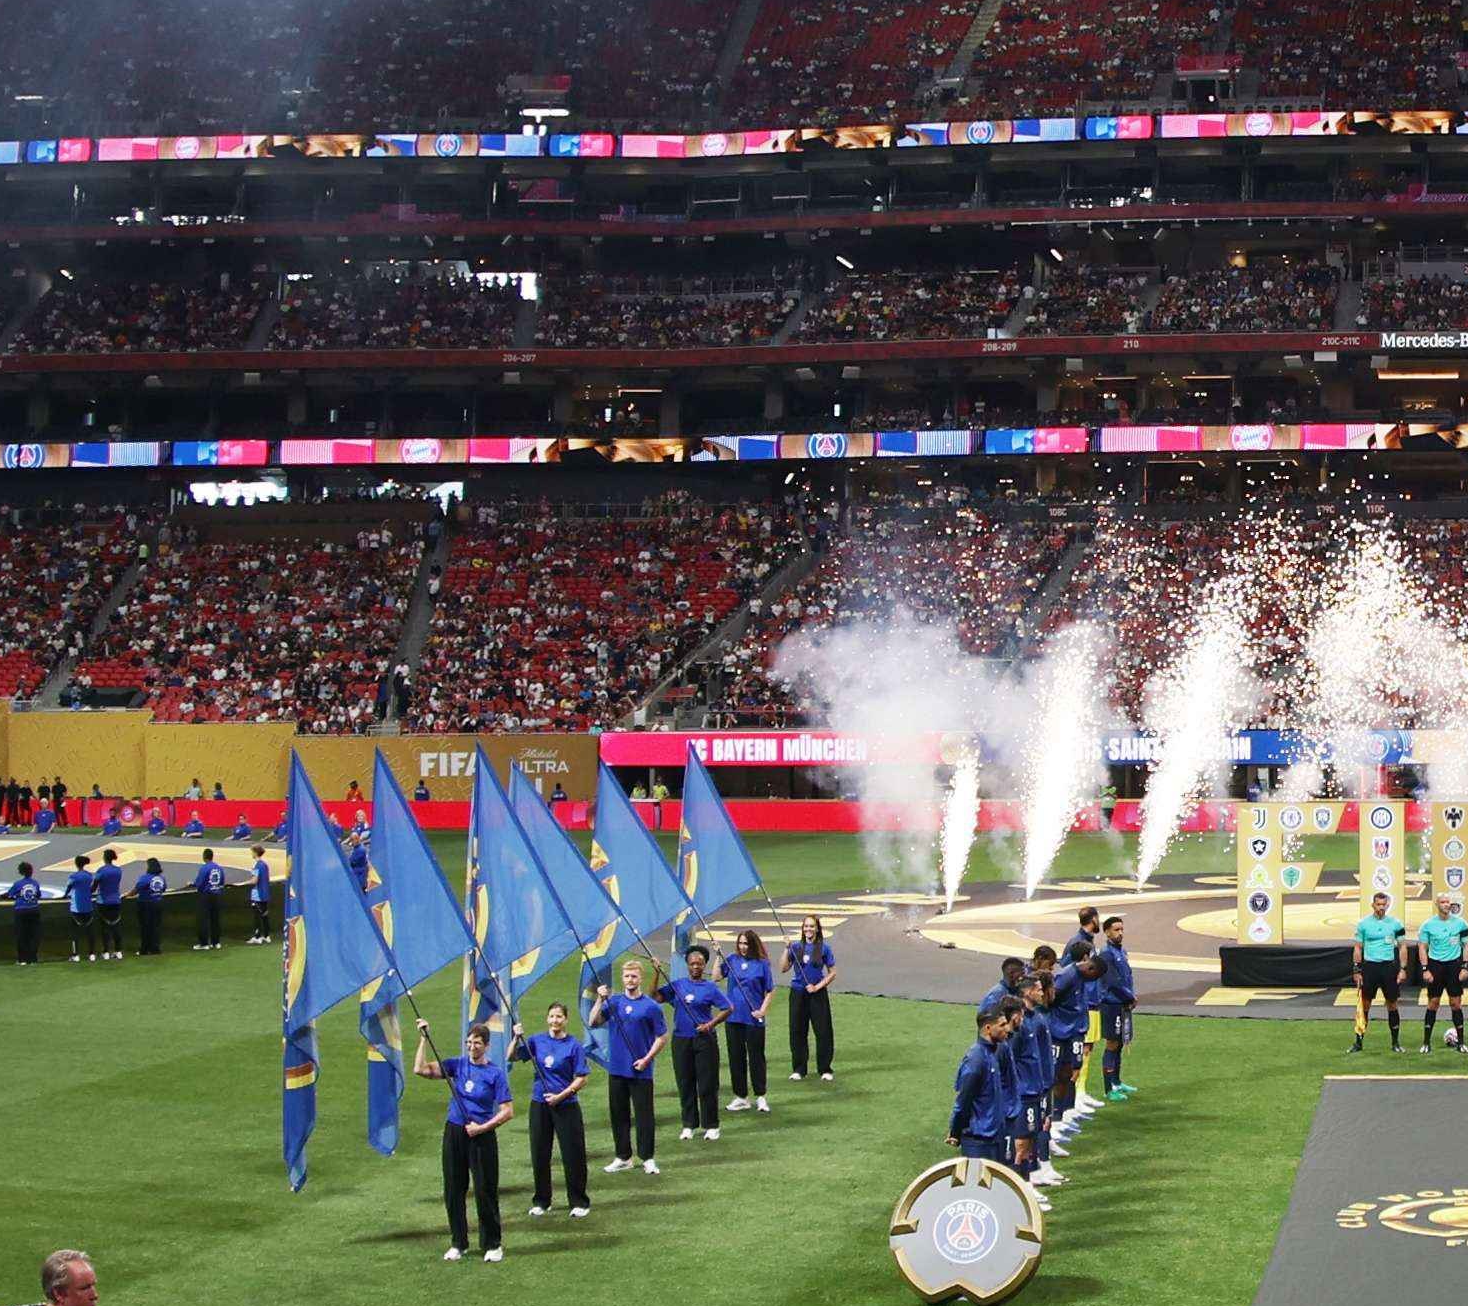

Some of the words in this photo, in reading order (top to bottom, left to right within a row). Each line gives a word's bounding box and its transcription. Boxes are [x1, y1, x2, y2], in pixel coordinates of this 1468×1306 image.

[1123, 340, 1139, 349] 210
[1322, 336, 1360, 347] 210C-211C
[712, 737, 777, 761] BAYERN
[783, 733, 867, 761] MÜNCHEN
[1026, 1107, 1035, 1123] 8
[947, 1201, 988, 1219] PARIS
[1335, 1202, 1378, 1229] CLUB
